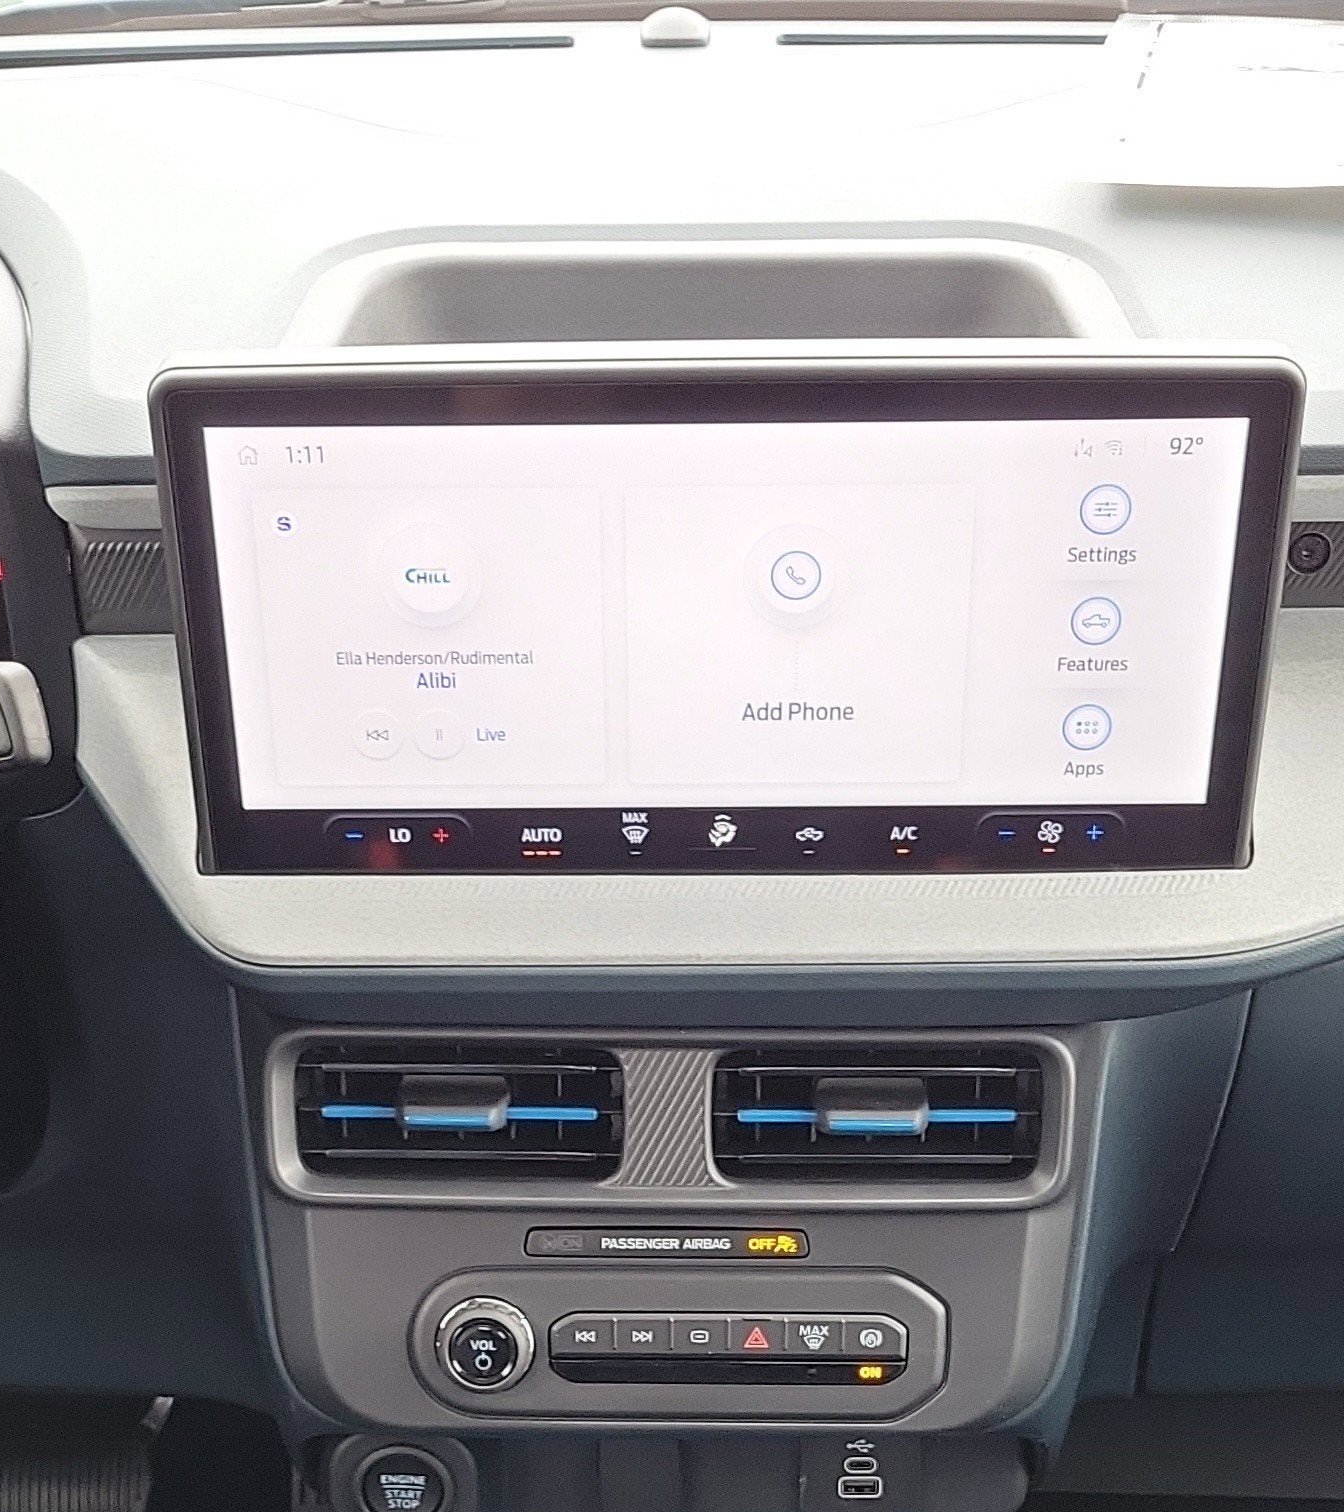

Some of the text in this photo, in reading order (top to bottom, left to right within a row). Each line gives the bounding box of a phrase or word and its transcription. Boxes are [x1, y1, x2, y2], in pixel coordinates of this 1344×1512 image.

[285, 445, 325, 464] 1:11
[276, 516, 292, 532] S
[1067, 546, 1137, 564] Settings
[336, 650, 534, 667] Ella Henderson/Rudimental
[1057, 656, 1128, 672] Features
[416, 672, 456, 689] Alibi
[742, 702, 854, 722] Add Phone
[476, 728, 506, 742] Live
[1063, 761, 1105, 779] Apps
[622, 812, 648, 823] MAX
[389, 828, 412, 843] LO
[521, 828, 563, 843] AUTO
[890, 826, 918, 841] A/C
[601, 1238, 680, 1250] PASSENGER
[683, 1238, 731, 1250] AIRBAG
[748, 1238, 776, 1250] OFF
[799, 1325, 829, 1336] MAX
[470, 1340, 496, 1351] VOL
[859, 1366, 882, 1378] ON
[380, 1474, 427, 1485] ENGINE
[384, 1489, 424, 1499] START
[387, 1499, 421, 1509] STOP
